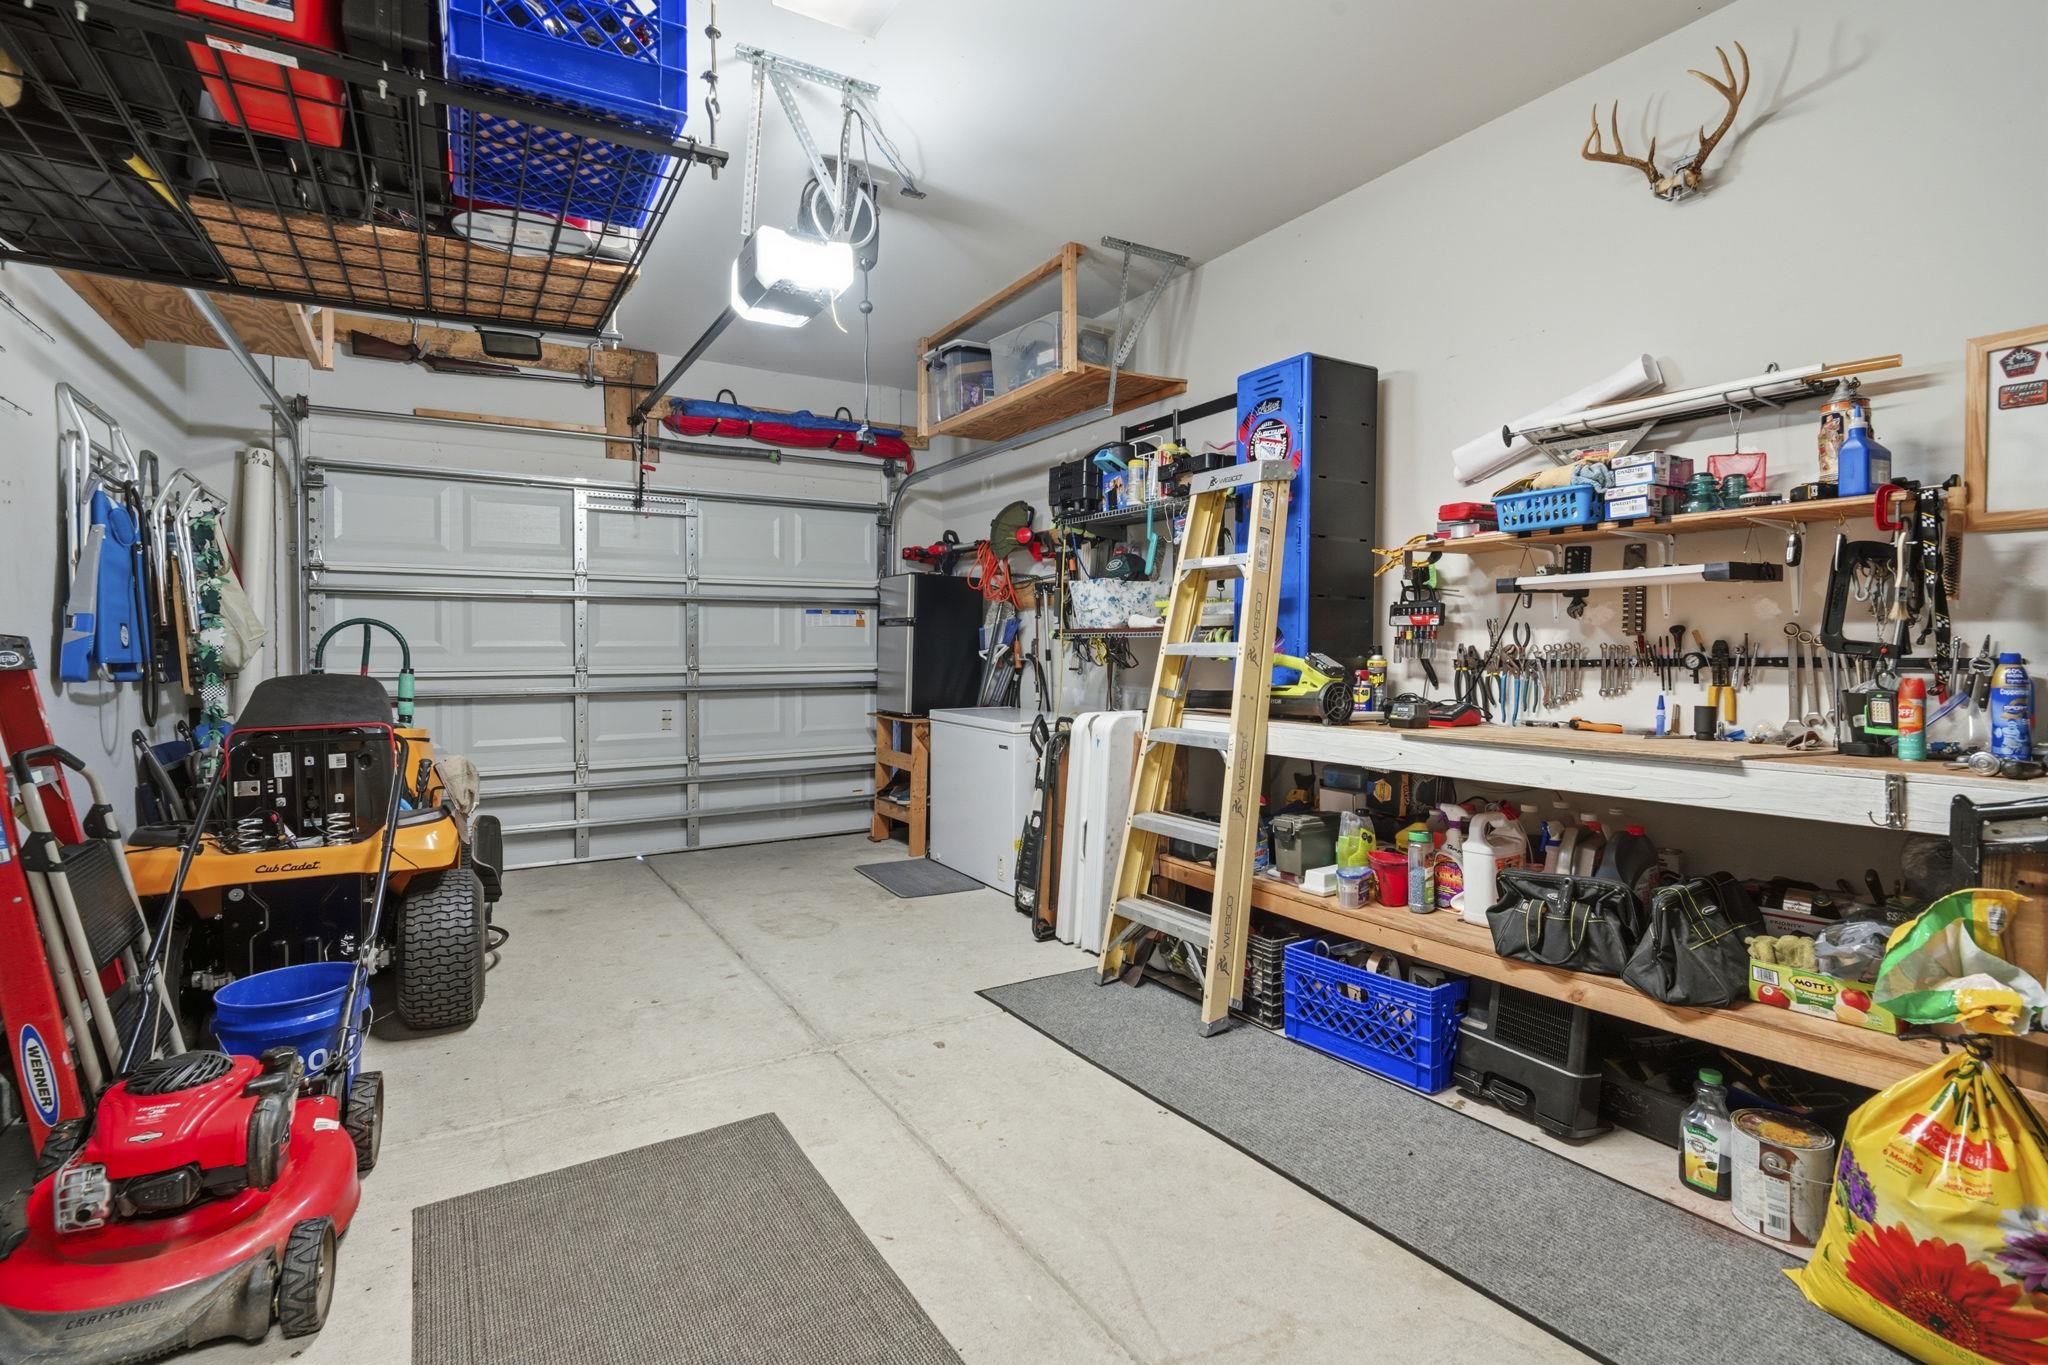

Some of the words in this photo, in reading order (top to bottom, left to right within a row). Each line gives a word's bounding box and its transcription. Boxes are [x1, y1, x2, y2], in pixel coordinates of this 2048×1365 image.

[255, 864, 280, 874] Cub
[281, 861, 321, 872] Cadet
[1222, 895, 1234, 950] WESCO
[1794, 978, 1833, 992] MOTT'S
[27, 1044, 53, 1108] WERNER
[1890, 1151, 1923, 1175] Months
[64, 1299, 164, 1331] CRAFTSMAN
